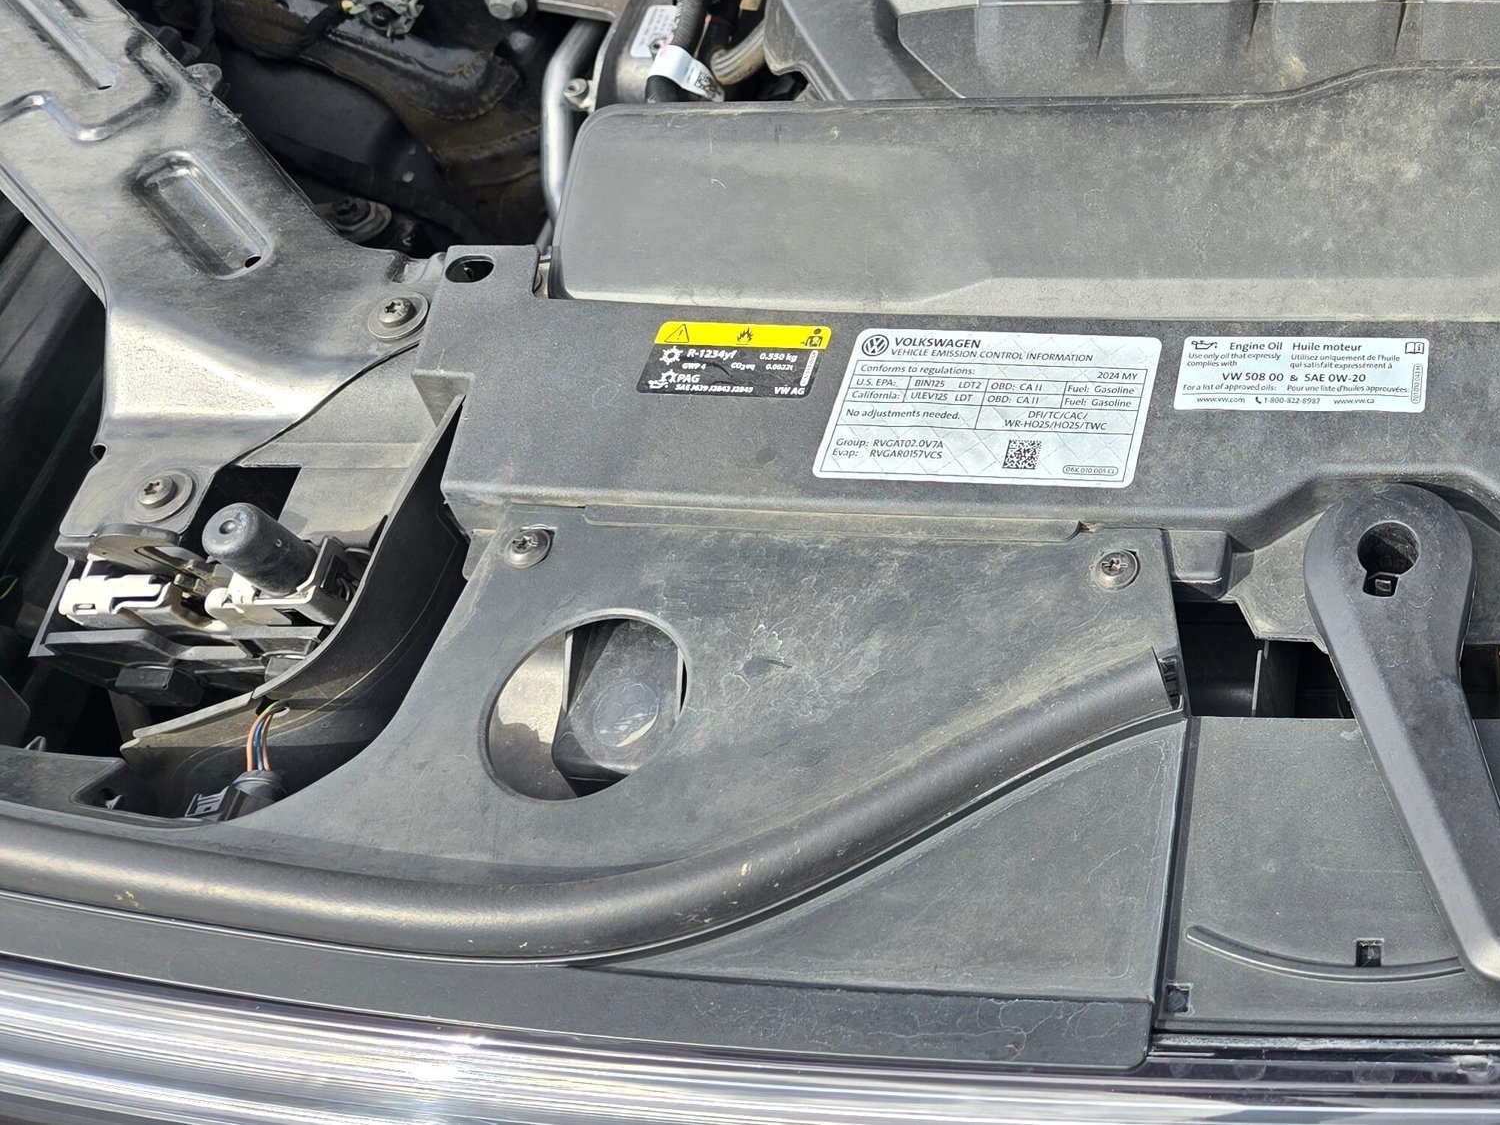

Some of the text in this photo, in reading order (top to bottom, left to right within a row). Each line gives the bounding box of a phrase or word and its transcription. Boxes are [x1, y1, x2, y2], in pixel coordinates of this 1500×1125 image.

[895, 337, 981, 348] VOLKSWAGEN
[1230, 341, 1282, 352] Engine Oil
[1292, 342, 1362, 351] Huile moteur
[786, 353, 798, 363] kg
[891, 348, 1093, 362] VEHICLE EMISSION CONTROL INFORMATION
[861, 364, 975, 375] Conforms to regulations:
[677, 374, 700, 383] PAG
[1098, 371, 1120, 379] 2024
[1245, 373, 1266, 381] 508
[1269, 373, 1284, 381] 00
[1304, 373, 1326, 382] SAE
[1328, 374, 1366, 382] 0W-20
[876, 379, 896, 387] EPA:
[915, 379, 982, 389] BIN125 LDT2
[991, 382, 1035, 391] OBD: CA
[774, 387, 805, 395] VW AG
[1068, 385, 1135, 394] Fuel: Gasoline
[852, 390, 900, 399] California:
[910, 392, 948, 401] ULEV125
[987, 395, 1031, 404] OBD: CA
[1064, 398, 1132, 407] Fuel: Gasoline
[862, 409, 920, 419] adjustments
[923, 411, 960, 420] needed.
[1028, 411, 1088, 419] DFI/TC/CAC/
[836, 438, 869, 447] Group:
[832, 448, 859, 457] Evap:
